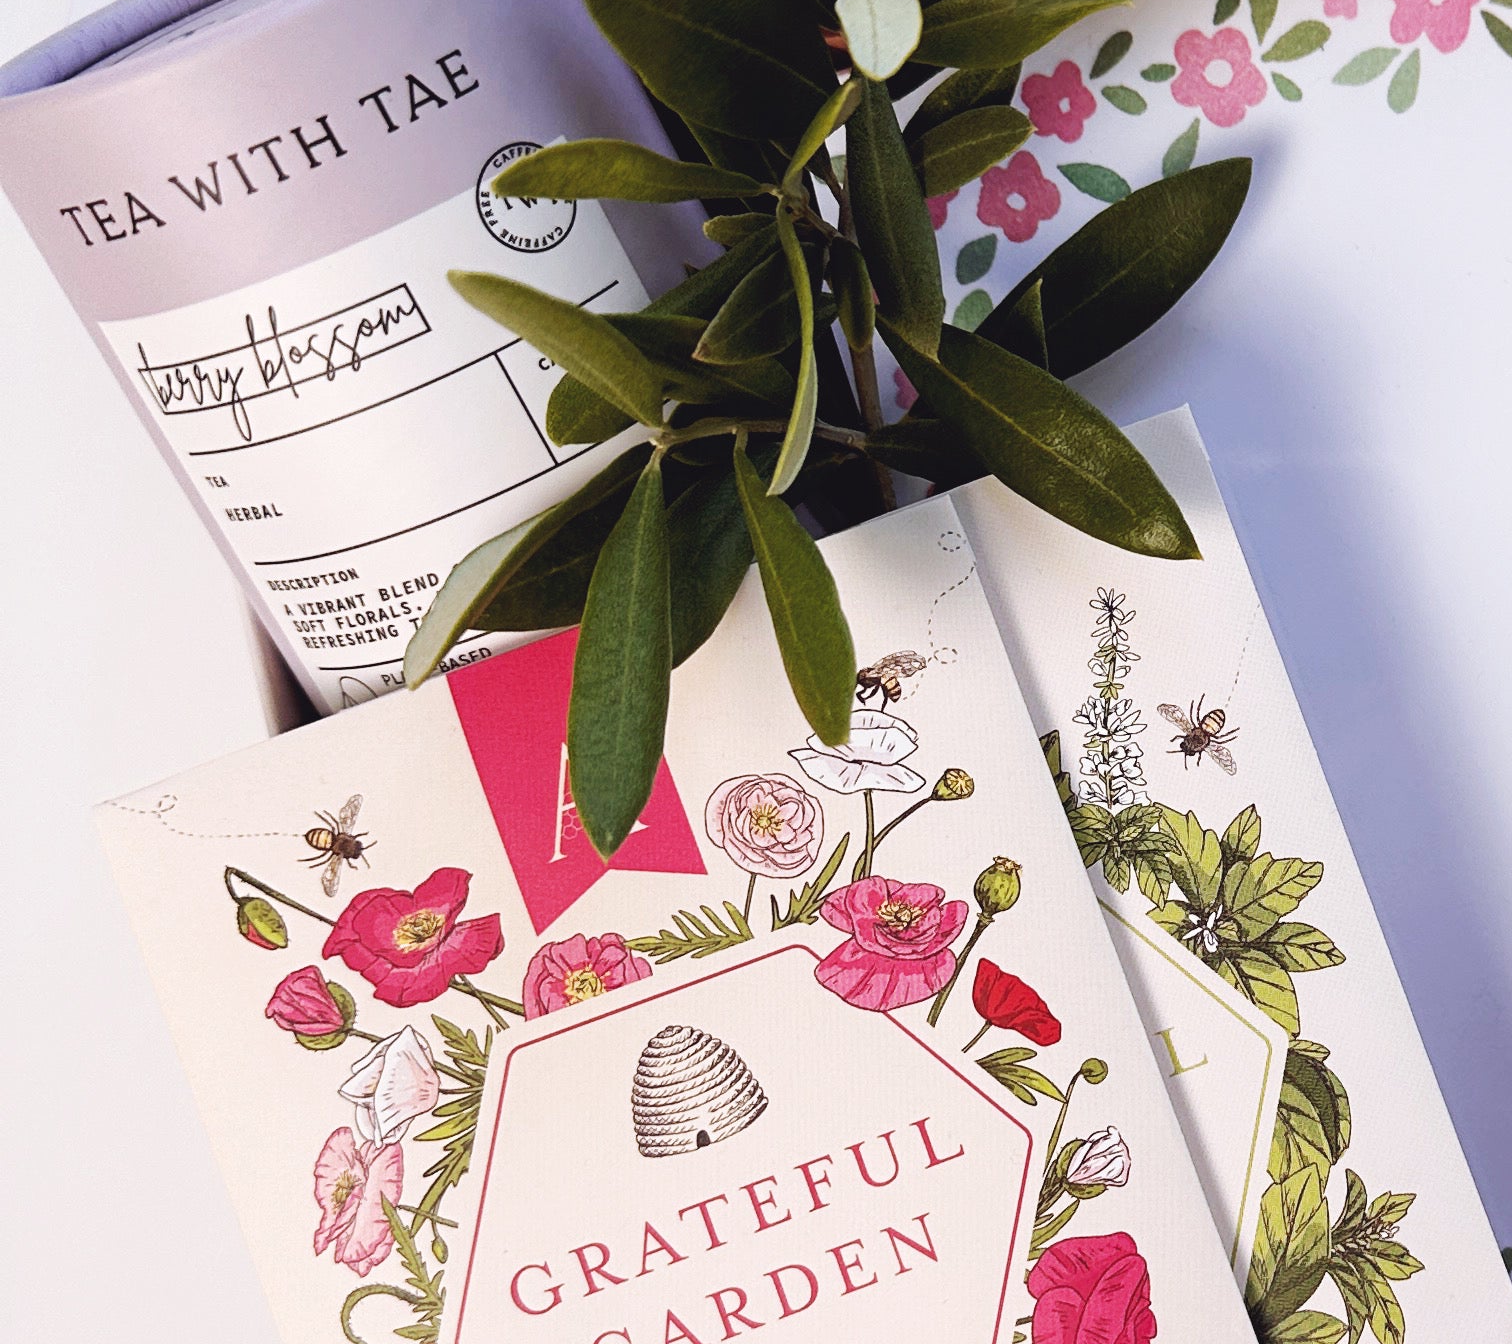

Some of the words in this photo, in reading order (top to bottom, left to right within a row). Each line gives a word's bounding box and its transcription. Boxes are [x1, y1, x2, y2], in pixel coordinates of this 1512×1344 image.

[60, 197, 166, 247] TEA
[168, 115, 348, 212] WITH
[358, 48, 481, 134] TAE
[480, 191, 498, 227] FREE
[500, 226, 564, 248] CAFFEINE
[245, 305, 416, 398] blossom
[205, 475, 231, 488] TEA
[225, 503, 283, 522] HERBAL
[267, 568, 360, 592] DESCRIPTION
[284, 605, 294, 616] A
[298, 594, 366, 616] VIBRANT
[378, 572, 440, 602] BLEND
[293, 620, 326, 633] SOFT
[302, 624, 400, 649] REFRESHING
[510, 1115, 966, 1317] GRATEFUL
